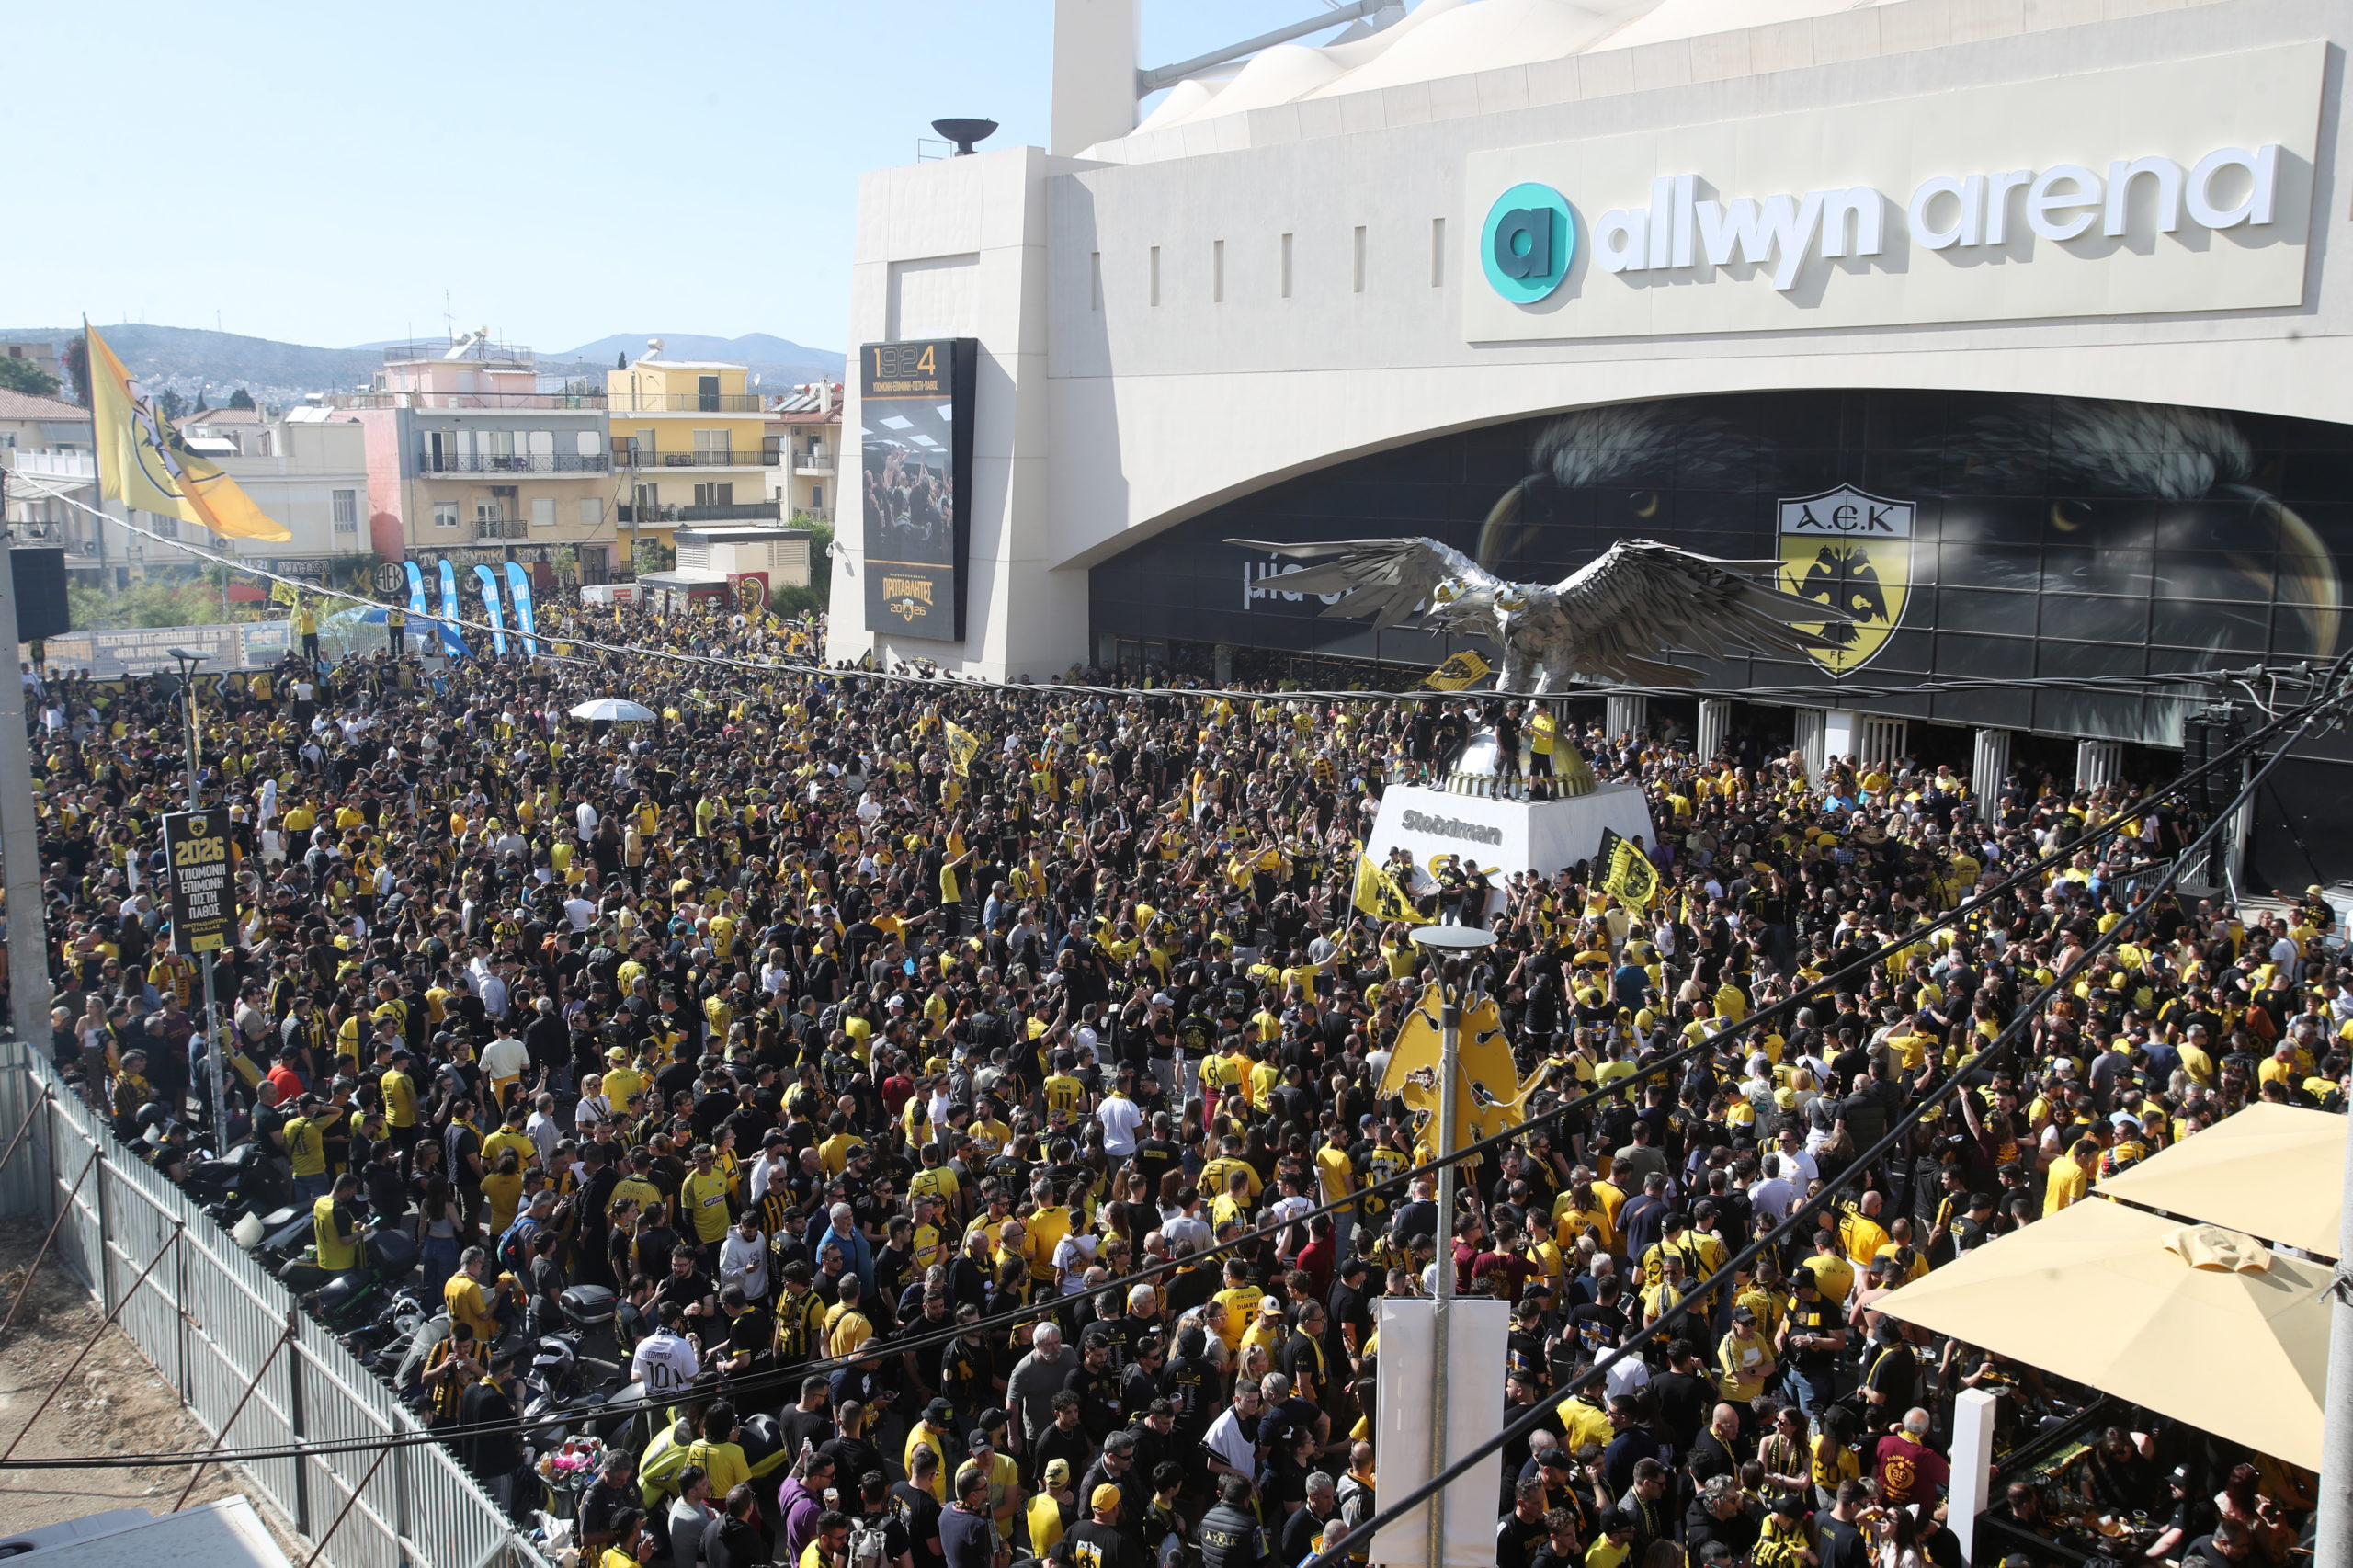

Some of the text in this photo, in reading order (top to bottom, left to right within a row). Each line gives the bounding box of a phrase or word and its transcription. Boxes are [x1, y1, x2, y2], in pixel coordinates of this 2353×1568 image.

[1594, 143, 2279, 290] allwyn arena
[874, 346, 936, 378] 1924
[883, 577, 933, 606] ΠΡΩΤΑΘΛΗΤΕΣ
[891, 604, 902, 613] 20
[1830, 651, 1847, 660] F.C.
[1299, 718, 1308, 728] 12
[1402, 809, 1503, 846] Stoiximan
[175, 836, 225, 866] 2026
[177, 864, 225, 881] ΥΠΟΜΟΝΗ
[181, 878, 224, 894] ΕΠΙΜΟΝΗ
[189, 892, 218, 906] ΠΙΣΤΗ
[188, 903, 222, 920] ΠΑΘΟΣ
[1058, 1092, 1071, 1110] 11
[1236, 1301, 1259, 1311] DUART
[1245, 1311, 1254, 1326] 5
[646, 1361, 669, 1389] 10
[1892, 1469, 1907, 1481] 35
